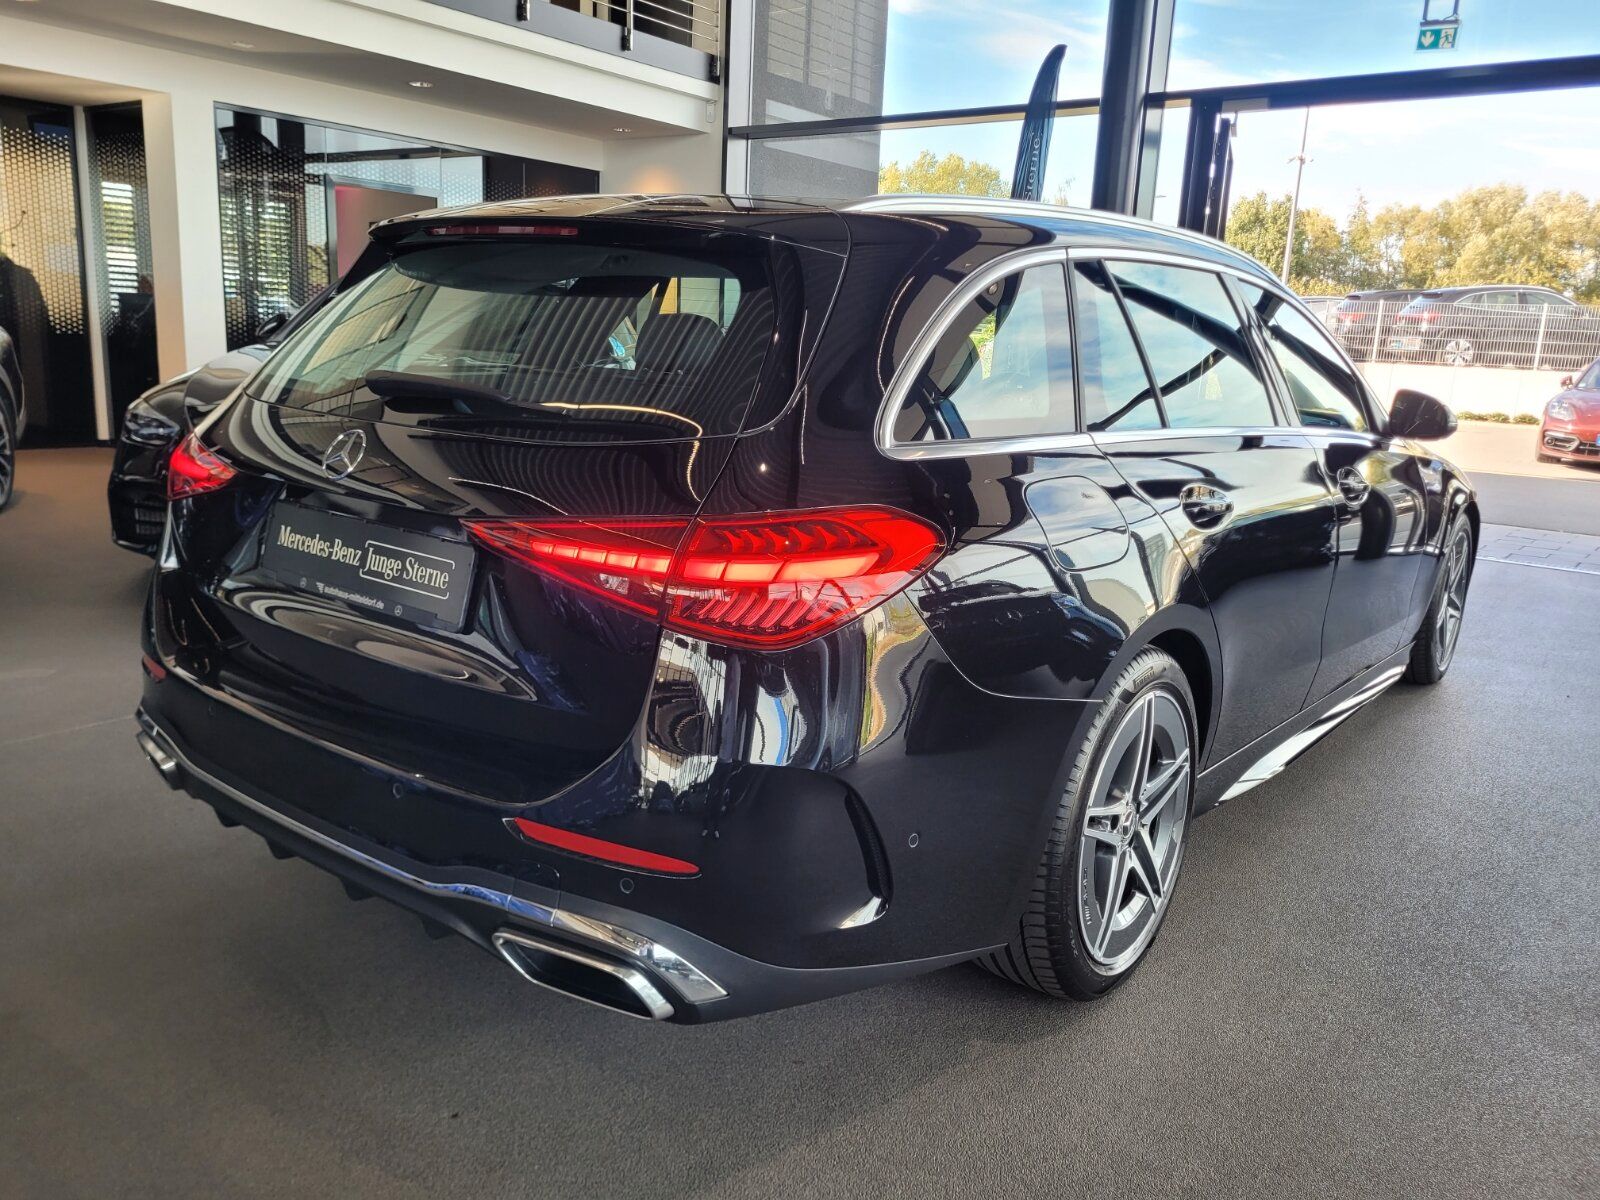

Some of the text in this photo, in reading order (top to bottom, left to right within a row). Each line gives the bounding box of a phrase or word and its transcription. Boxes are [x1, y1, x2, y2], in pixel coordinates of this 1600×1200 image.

[277, 524, 449, 590] Mercedes-Benz Junge Sterne
